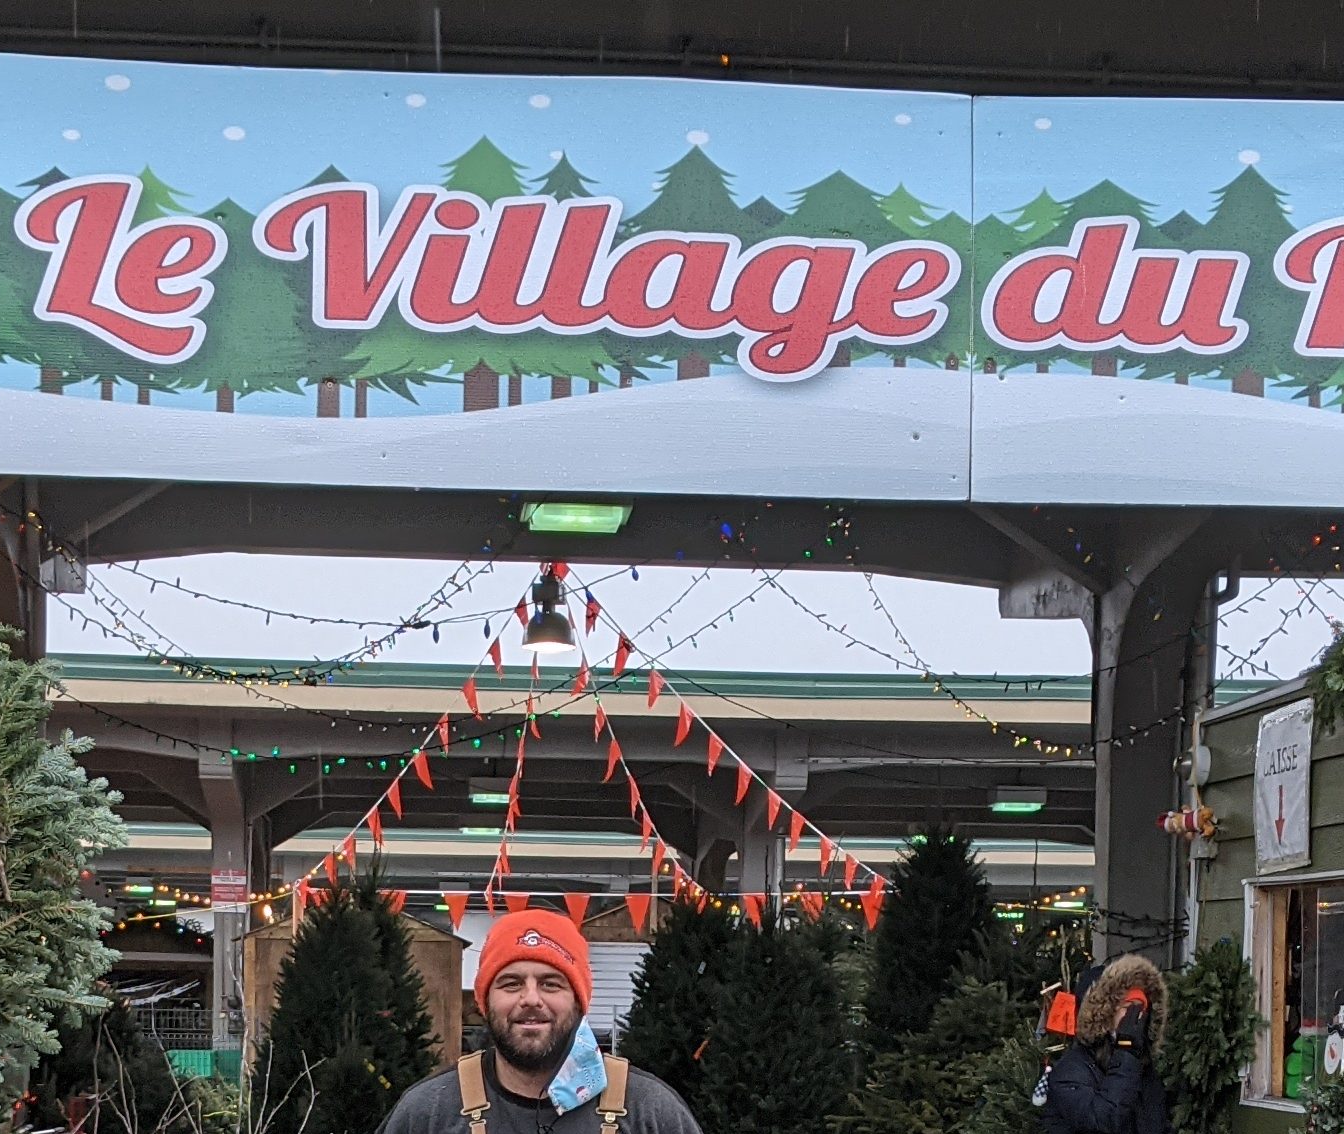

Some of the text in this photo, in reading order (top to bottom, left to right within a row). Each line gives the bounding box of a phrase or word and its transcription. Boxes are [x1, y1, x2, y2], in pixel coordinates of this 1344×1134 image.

[16, 176, 226, 361] Le
[255, 183, 959, 380] Village
[984, 217, 1246, 352] du
[1263, 743, 1299, 777] CAISSE
